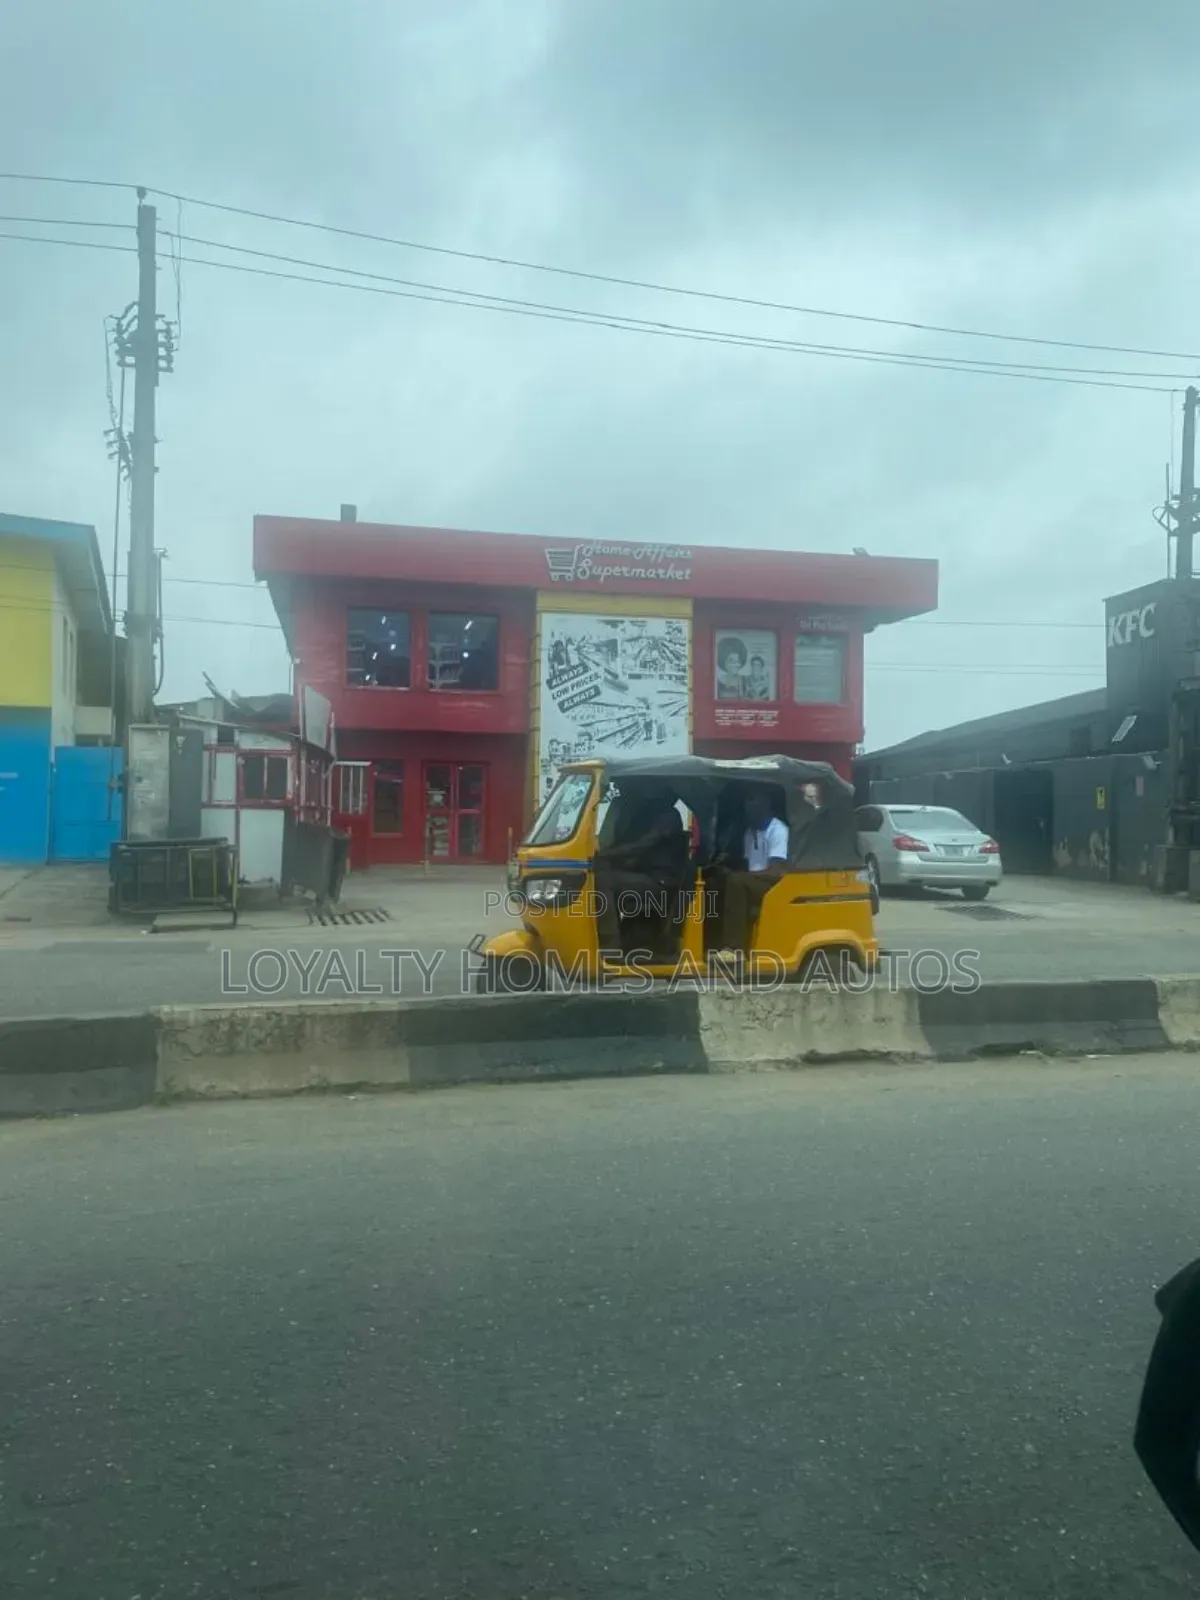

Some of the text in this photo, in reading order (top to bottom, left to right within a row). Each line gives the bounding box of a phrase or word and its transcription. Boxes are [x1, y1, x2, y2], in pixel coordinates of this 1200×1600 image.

[577, 559, 691, 584] Supermarket
[1107, 602, 1157, 647] KFC
[552, 686, 570, 700] LOW
